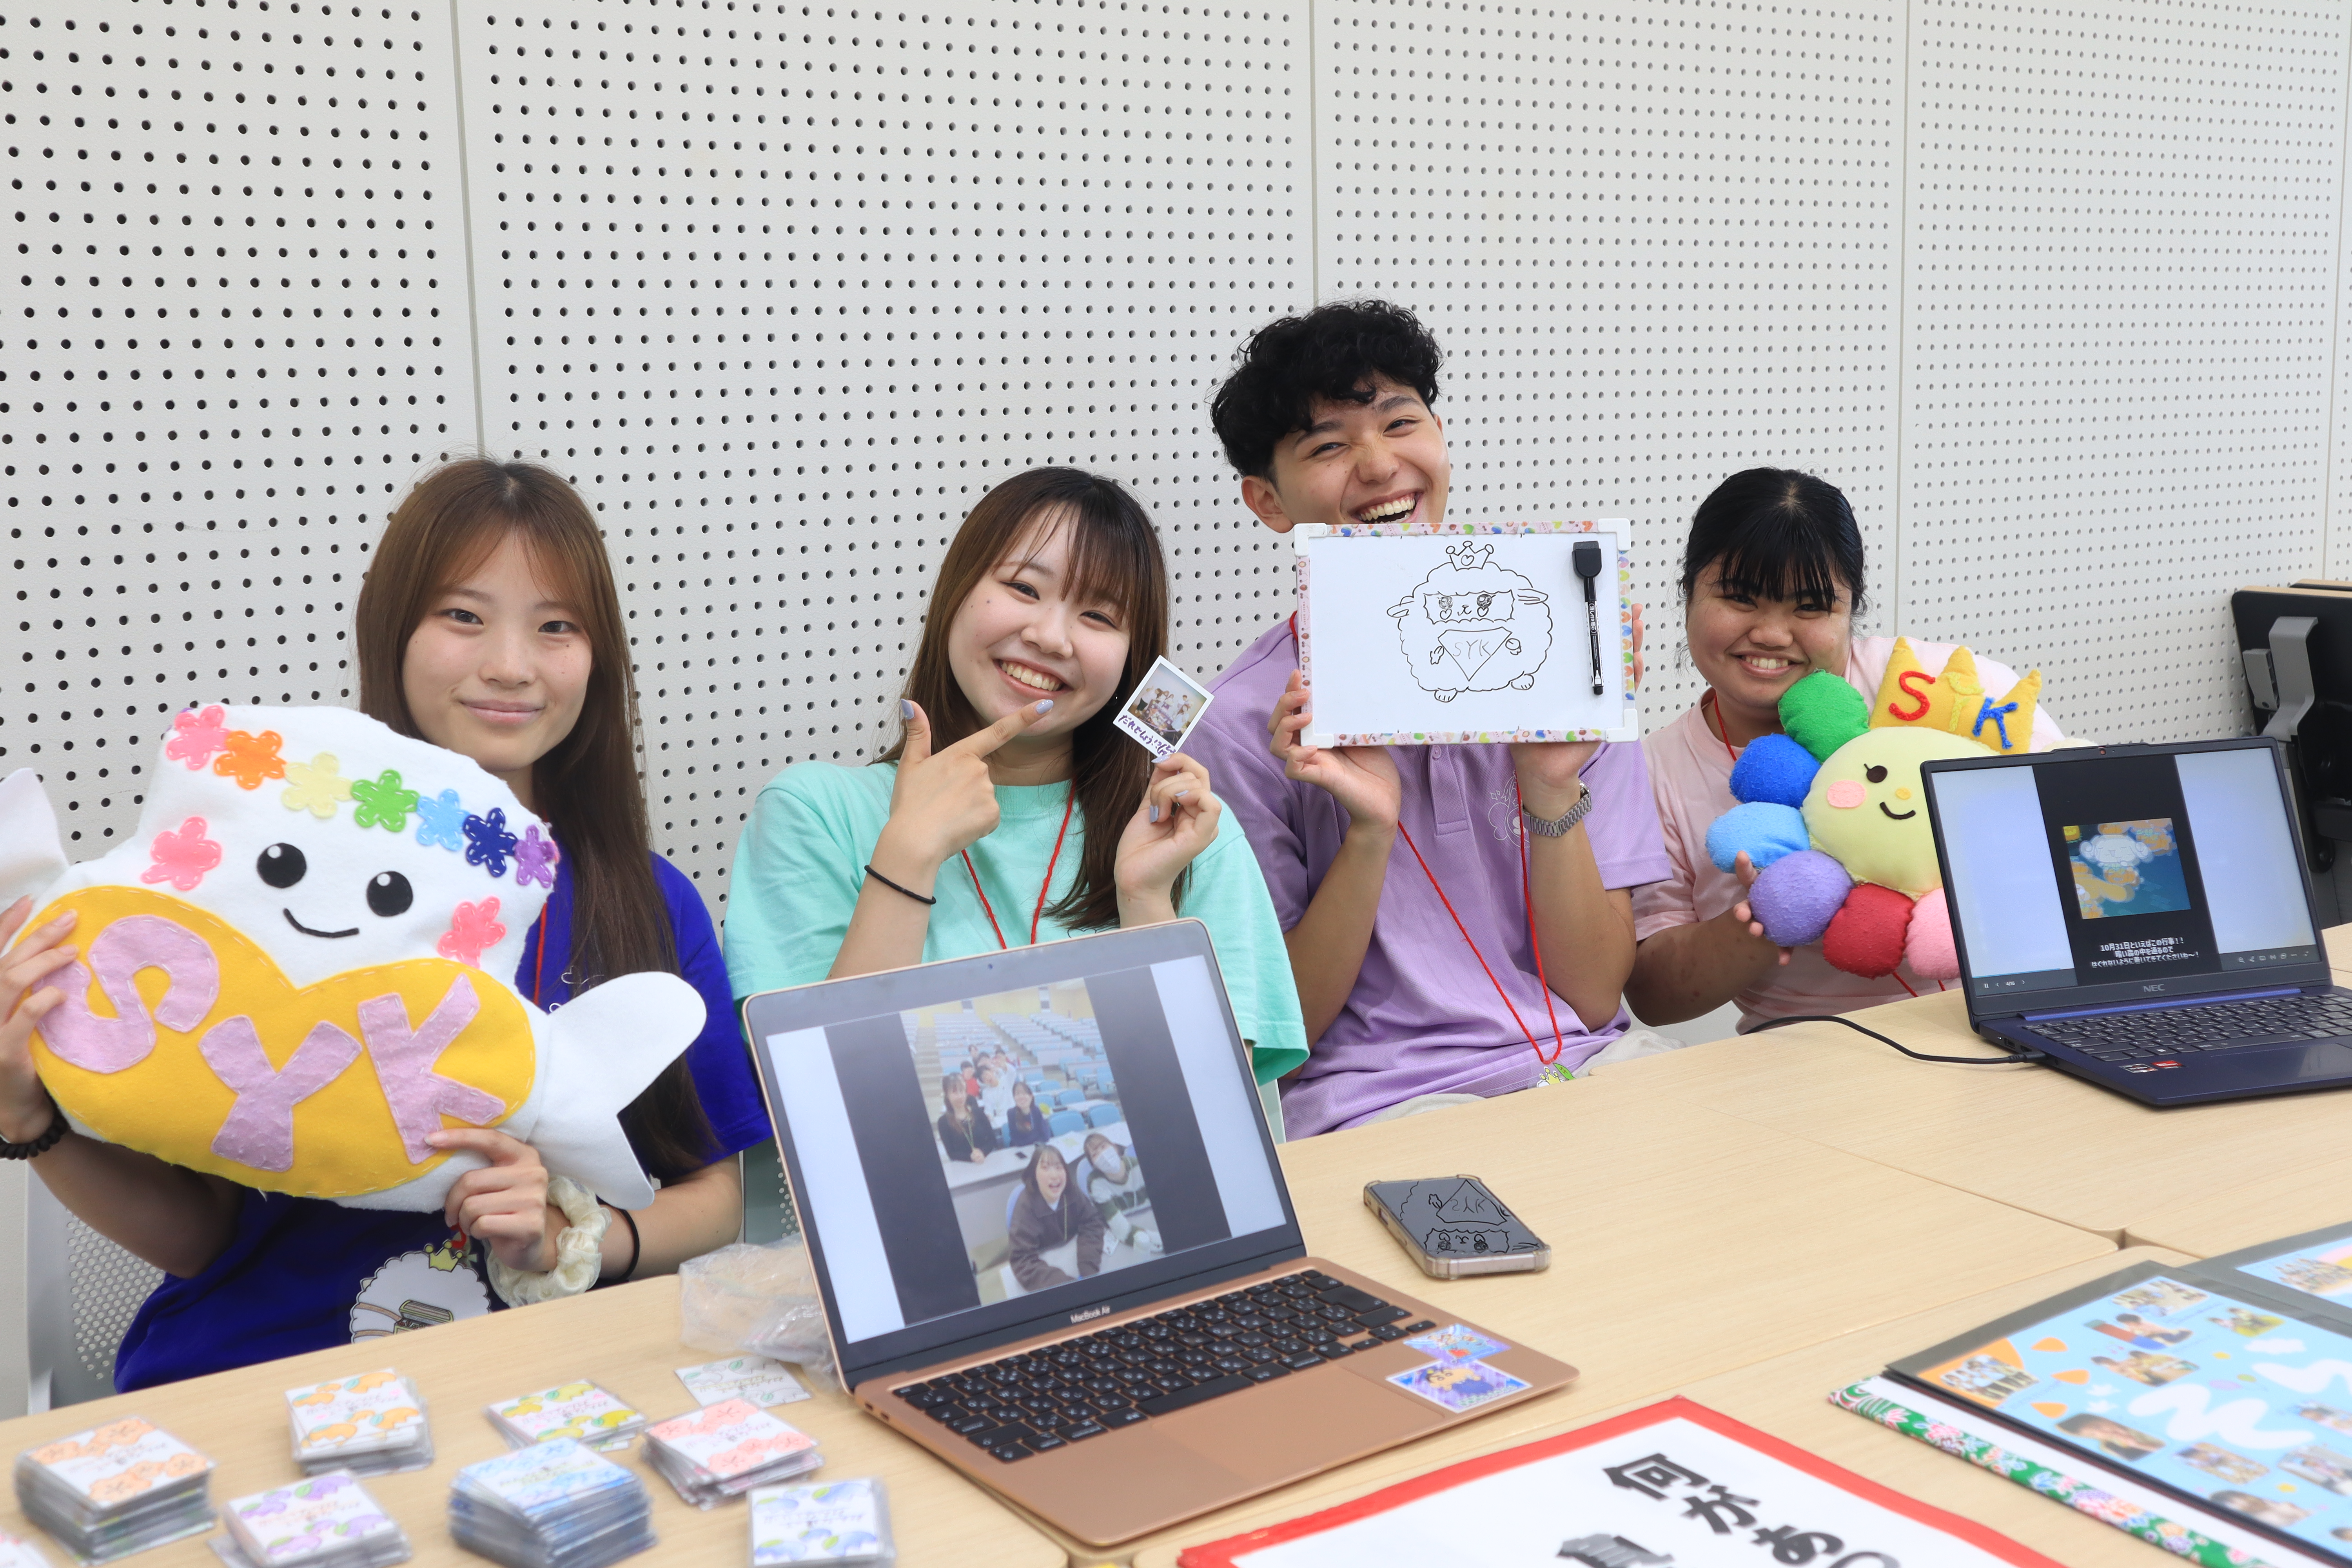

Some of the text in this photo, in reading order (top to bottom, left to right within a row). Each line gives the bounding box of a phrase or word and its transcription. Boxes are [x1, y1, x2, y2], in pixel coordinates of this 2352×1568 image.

[1453, 639, 1491, 659] SYK
[1888, 671, 2018, 749] SYK
[2143, 984, 2165, 993] NEC
[31, 914, 506, 1172] SYK
[1070, 1305, 1111, 1324] MacBook Air
